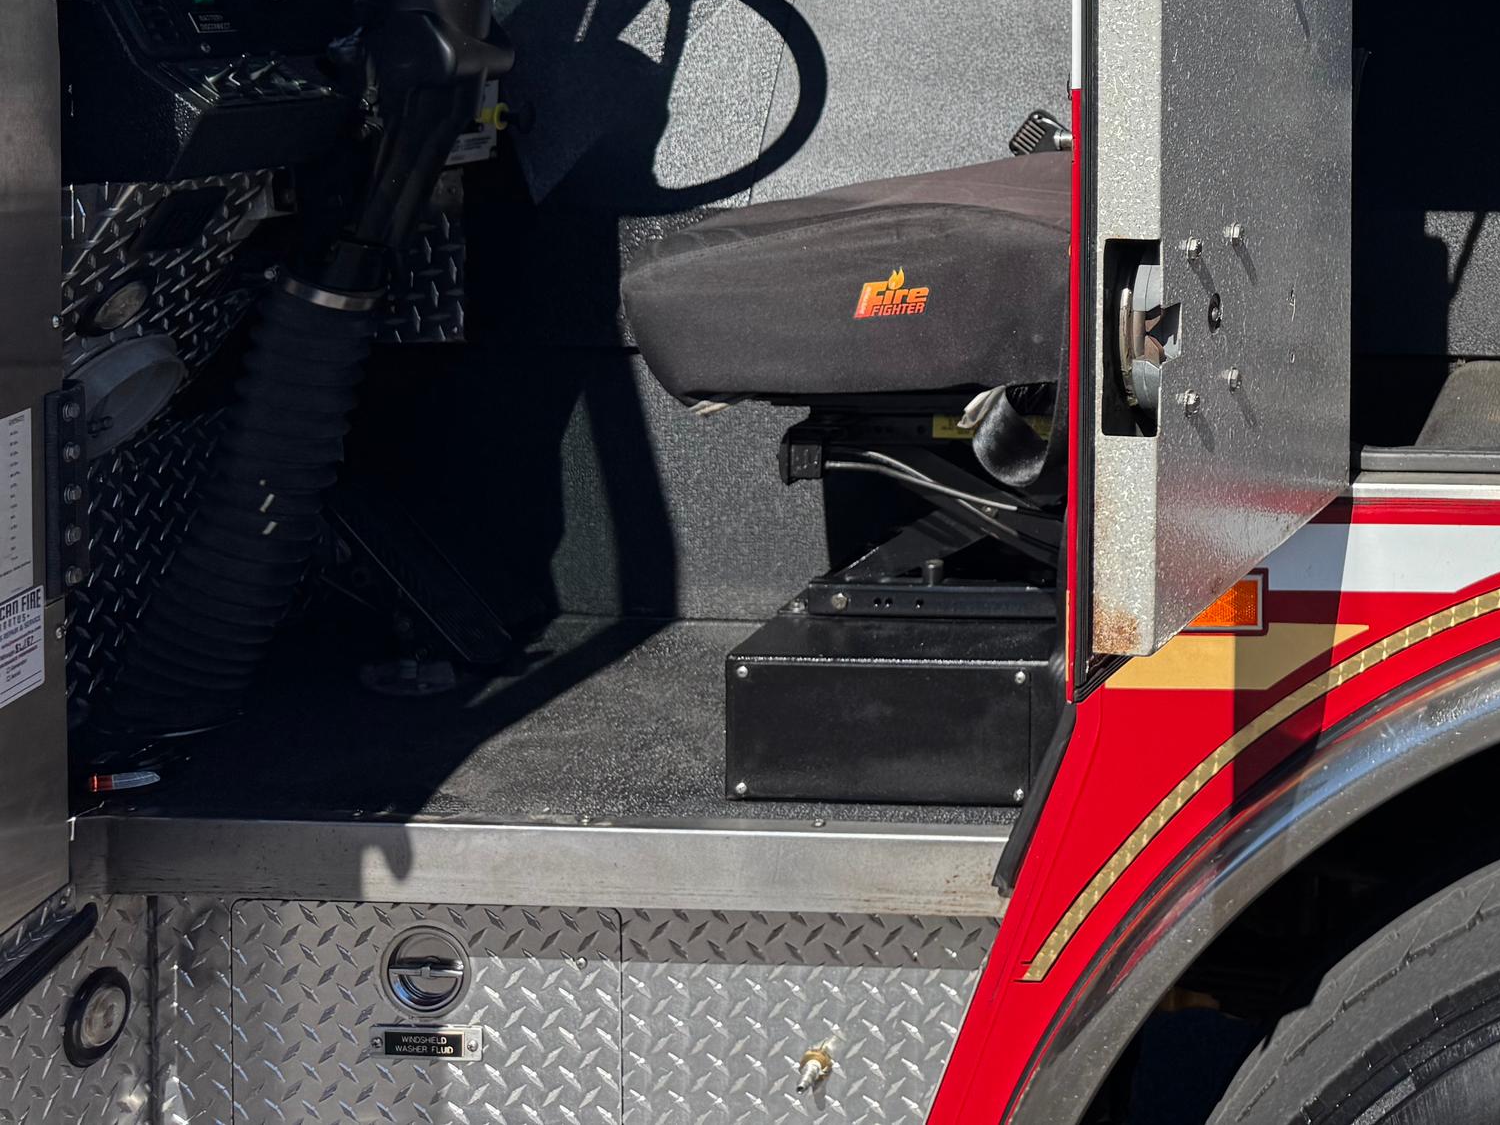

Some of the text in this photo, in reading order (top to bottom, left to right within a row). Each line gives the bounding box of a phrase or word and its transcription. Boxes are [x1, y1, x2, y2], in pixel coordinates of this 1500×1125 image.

[872, 302, 925, 316] FIGHTER
[22, 589, 41, 611] FIRE
[402, 1036, 447, 1044] WINDSHIELD
[395, 1045, 427, 1053] WASHER
